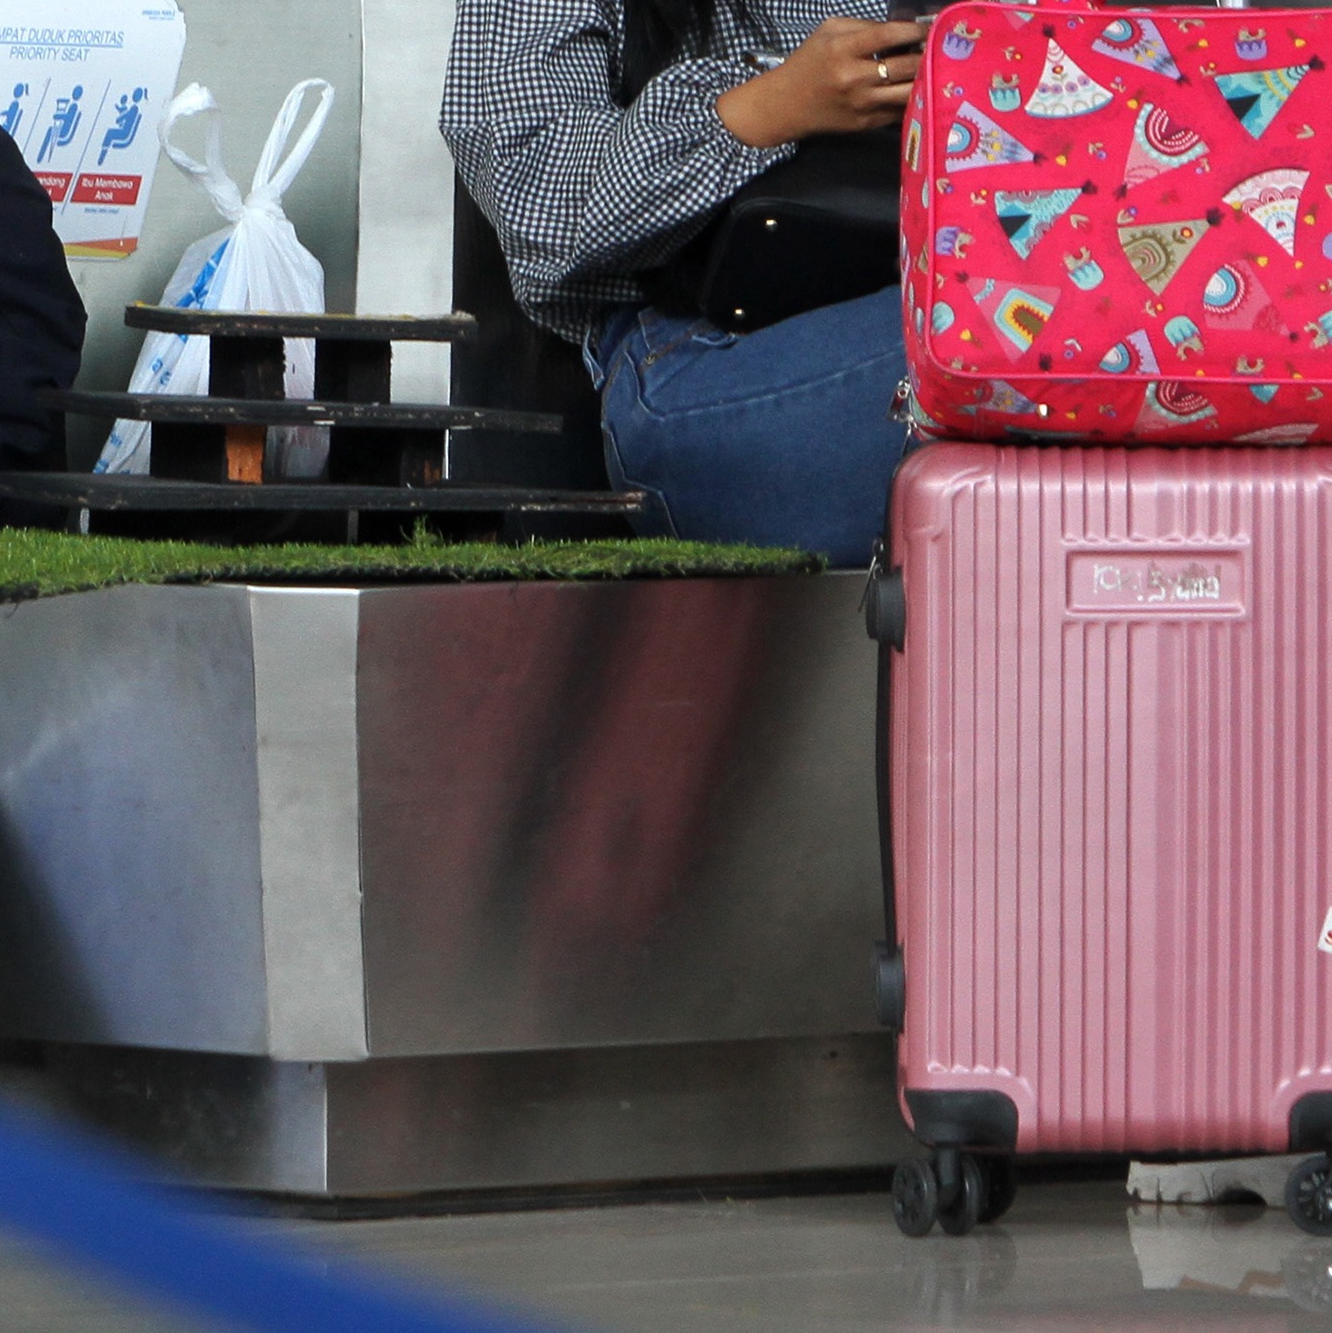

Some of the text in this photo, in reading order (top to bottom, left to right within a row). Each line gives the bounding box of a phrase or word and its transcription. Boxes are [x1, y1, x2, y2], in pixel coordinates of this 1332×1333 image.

[28, 27, 66, 43] DUDUK
[67, 28, 125, 45] PRIORITAS
[9, 46, 91, 62] PRIORITY SEAT
